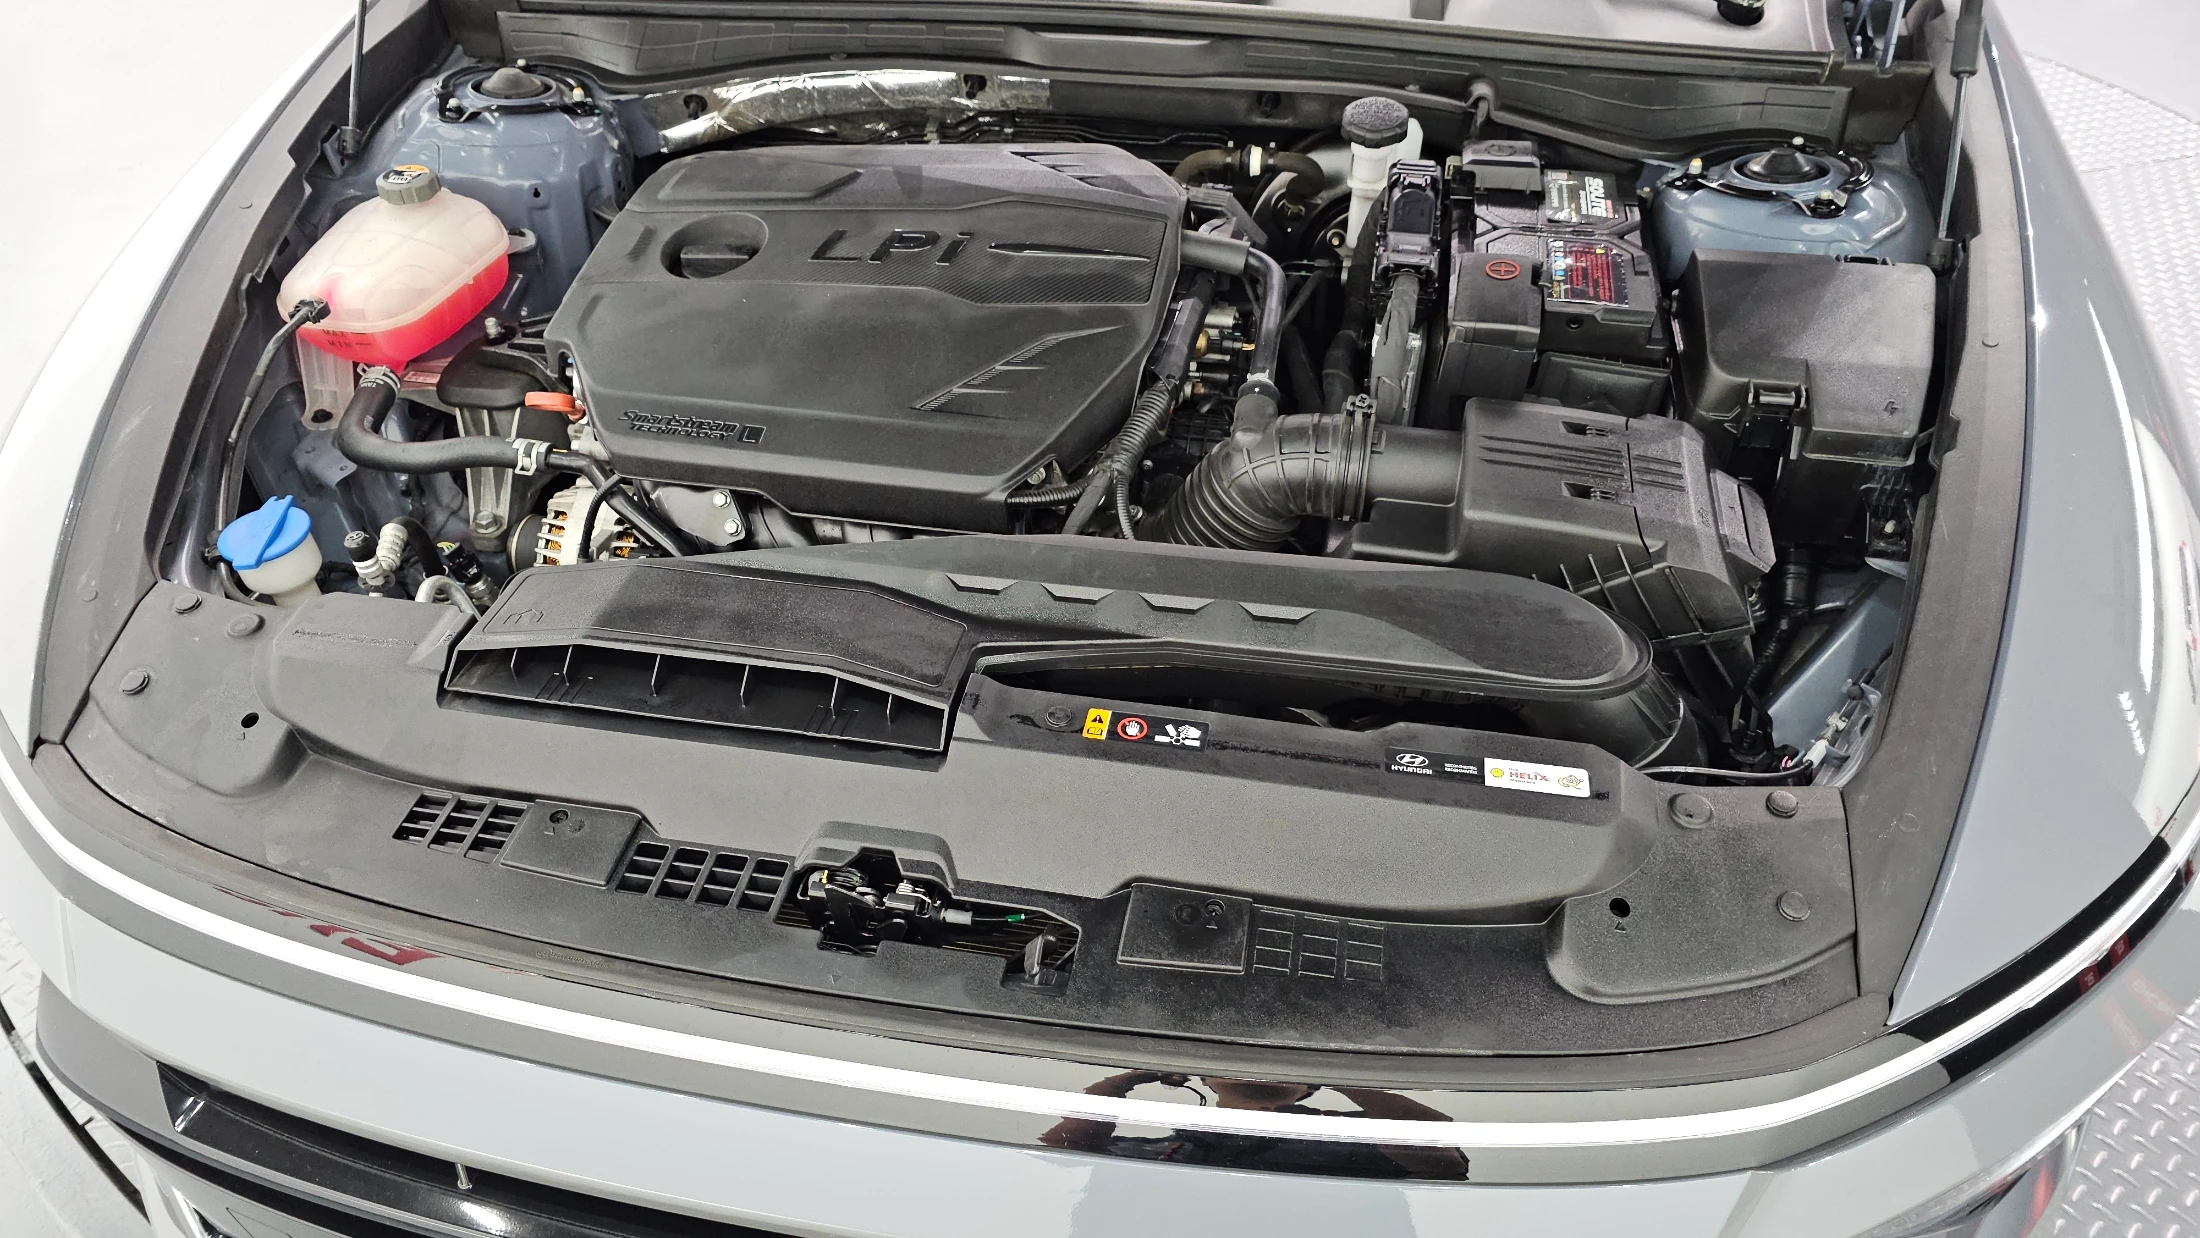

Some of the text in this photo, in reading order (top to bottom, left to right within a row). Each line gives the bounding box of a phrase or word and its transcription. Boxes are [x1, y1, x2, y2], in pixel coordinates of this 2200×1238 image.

[807, 228, 974, 266] LPi
[618, 409, 740, 434] Smartstream
[629, 421, 733, 441] TECHNOLOGY
[1391, 764, 1433, 775] HYUNDAI
[1509, 771, 1548, 781] HELIX
